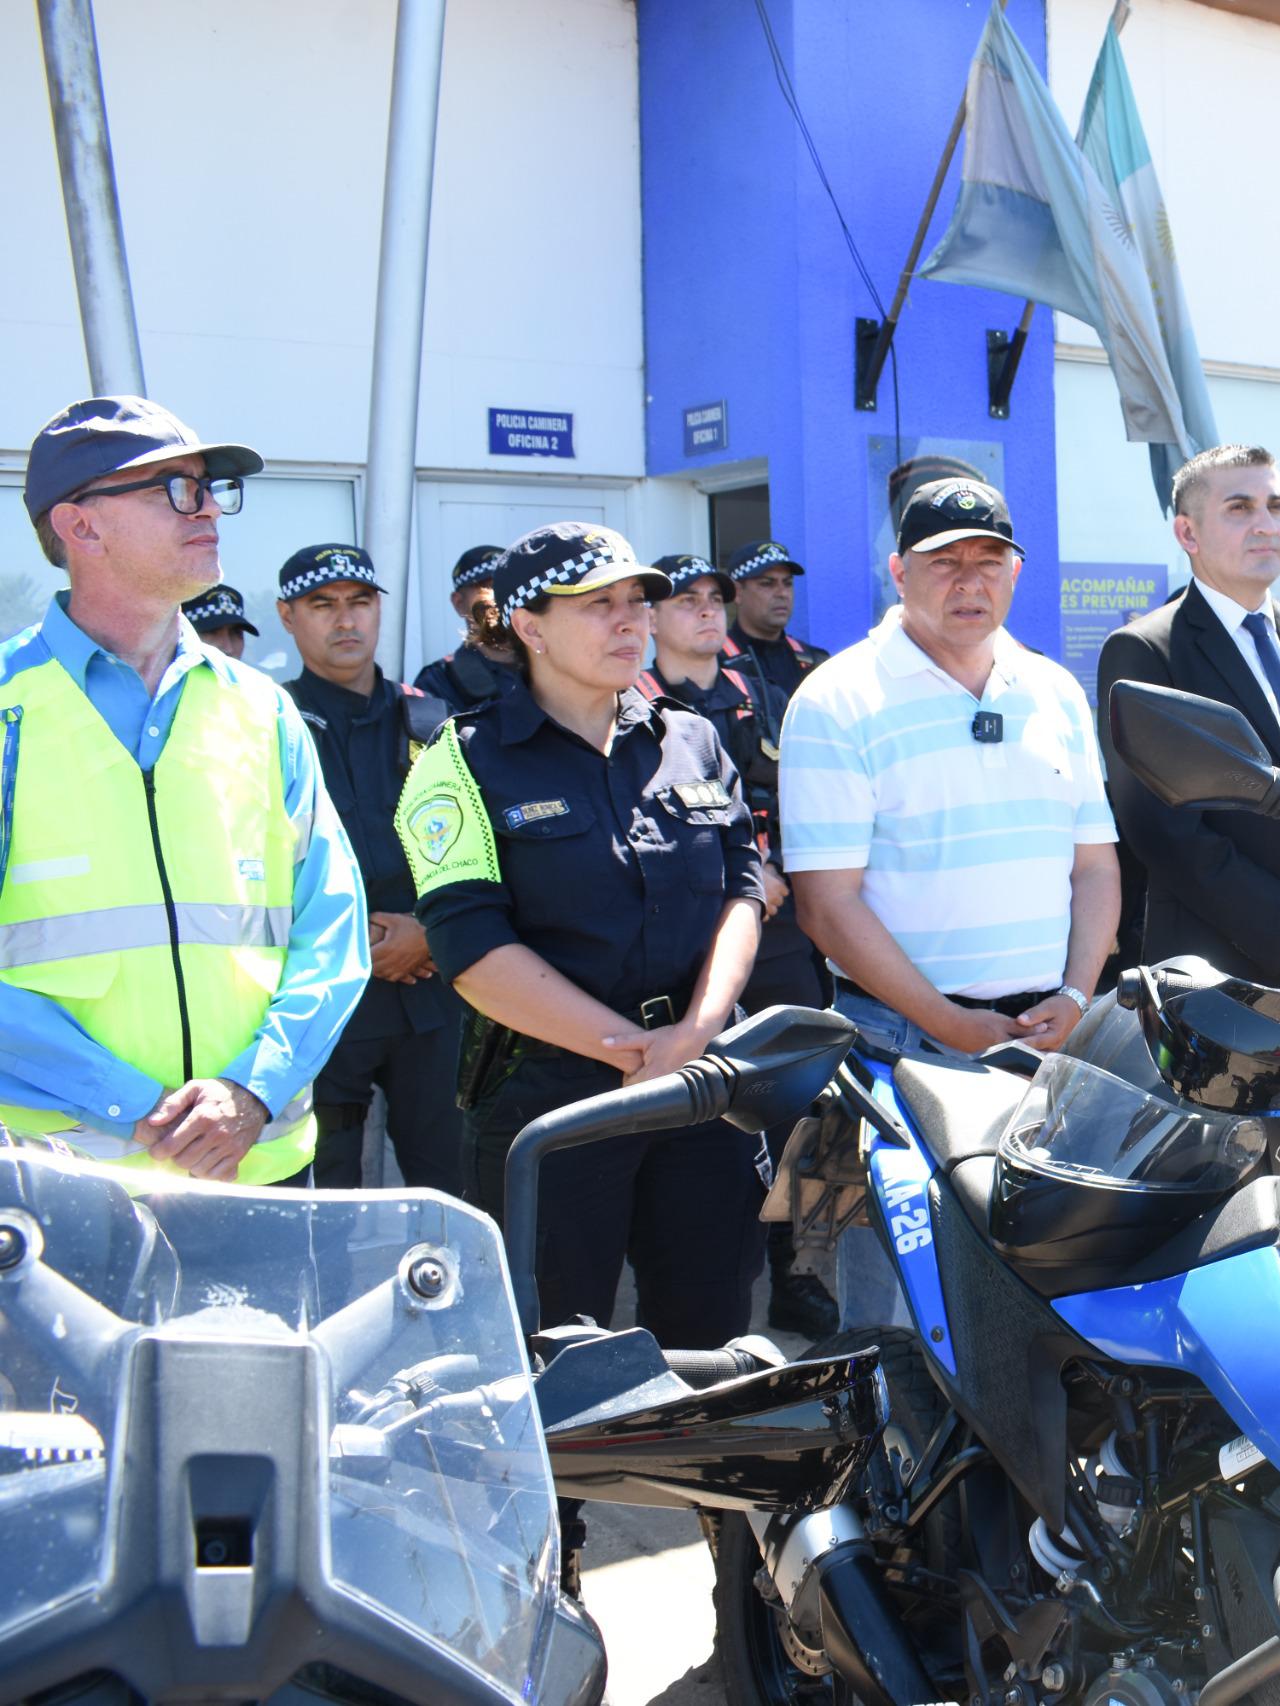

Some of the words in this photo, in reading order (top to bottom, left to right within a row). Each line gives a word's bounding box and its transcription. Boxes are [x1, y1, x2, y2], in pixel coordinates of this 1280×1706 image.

[496, 413, 527, 430] POLICIA
[527, 415, 568, 433] CAMINERA
[508, 433, 549, 449] OFICINA
[551, 436, 558, 450] 2
[1061, 576, 1155, 593] ACOMPAÑAR
[1061, 594, 1078, 608] ES
[1082, 594, 1149, 608] PREVENIR
